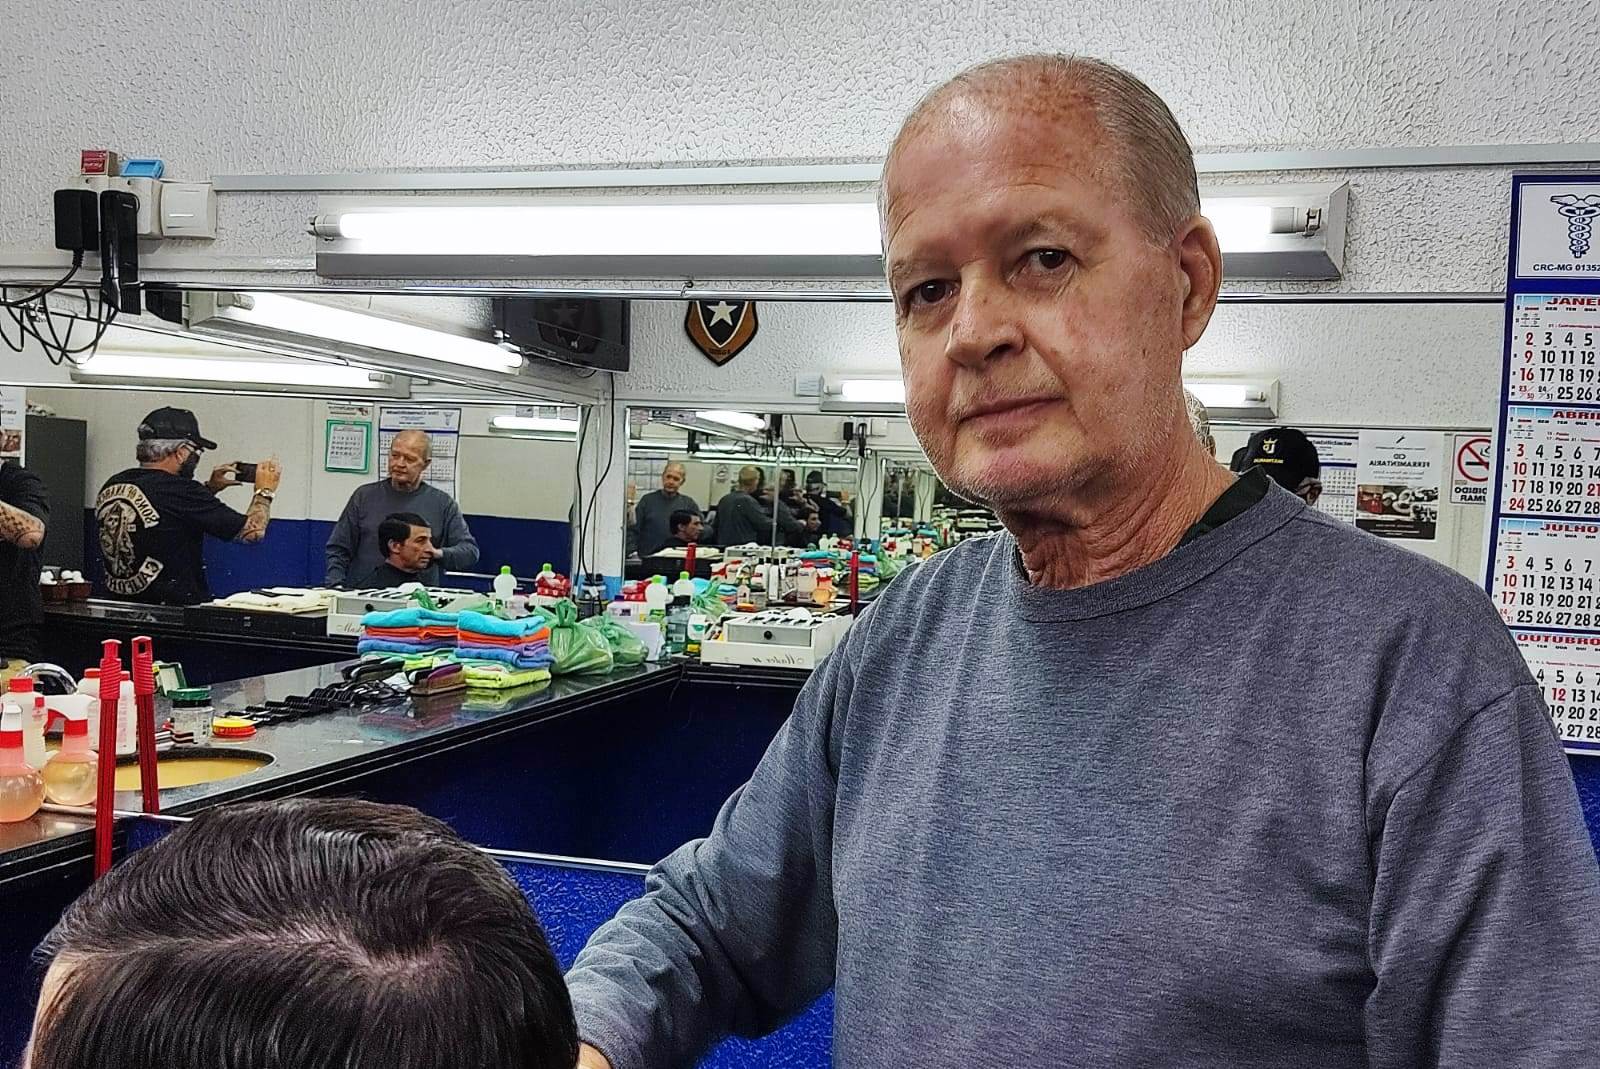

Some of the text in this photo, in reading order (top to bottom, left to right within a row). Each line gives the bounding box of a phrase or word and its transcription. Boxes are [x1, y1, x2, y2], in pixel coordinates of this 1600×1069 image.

[1526, 332, 1592, 346] 2 3 4 5
[1524, 350, 1595, 364] 9 10 11 12
[1520, 368, 1594, 383] 16 17 18 19
[1557, 387, 1573, 400] 25
[1577, 387, 1592, 400] 26
[1517, 444, 1524, 457] 3
[1536, 445, 1544, 458] 4
[1554, 446, 1563, 458] 5
[1574, 446, 1581, 459] 6
[1513, 462, 1527, 475] 10
[1532, 463, 1544, 476] 11
[1550, 464, 1564, 477] 12
[1569, 464, 1583, 478] 13
[1512, 480, 1600, 496] 17 18 19 20 21
[1509, 498, 1600, 514] 24 25 26 27 28
[1540, 524, 1598, 533] JULHO
[1506, 556, 1592, 573] 3 4 5 6 7
[1504, 574, 1592, 591] 10 11 12 13 14
[1502, 592, 1516, 604] 17
[1520, 592, 1534, 605] 18
[1540, 593, 1553, 606] 19
[1558, 594, 1573, 607] 20
[1578, 596, 1592, 609] 21
[1517, 610, 1533, 623] 25
[1536, 611, 1552, 624] 26
[1555, 612, 1571, 625] 27
[1574, 614, 1590, 626] 28
[1517, 634, 1600, 645] OUTUBRO
[1536, 669, 1544, 682] 4
[1556, 670, 1564, 683] 5
[1576, 671, 1583, 684] 6
[1552, 688, 1566, 701] 12
[1571, 689, 1586, 702] 13
[1550, 705, 1564, 718] 19
[1568, 707, 1584, 719] 20
[1567, 724, 1583, 737] 27
